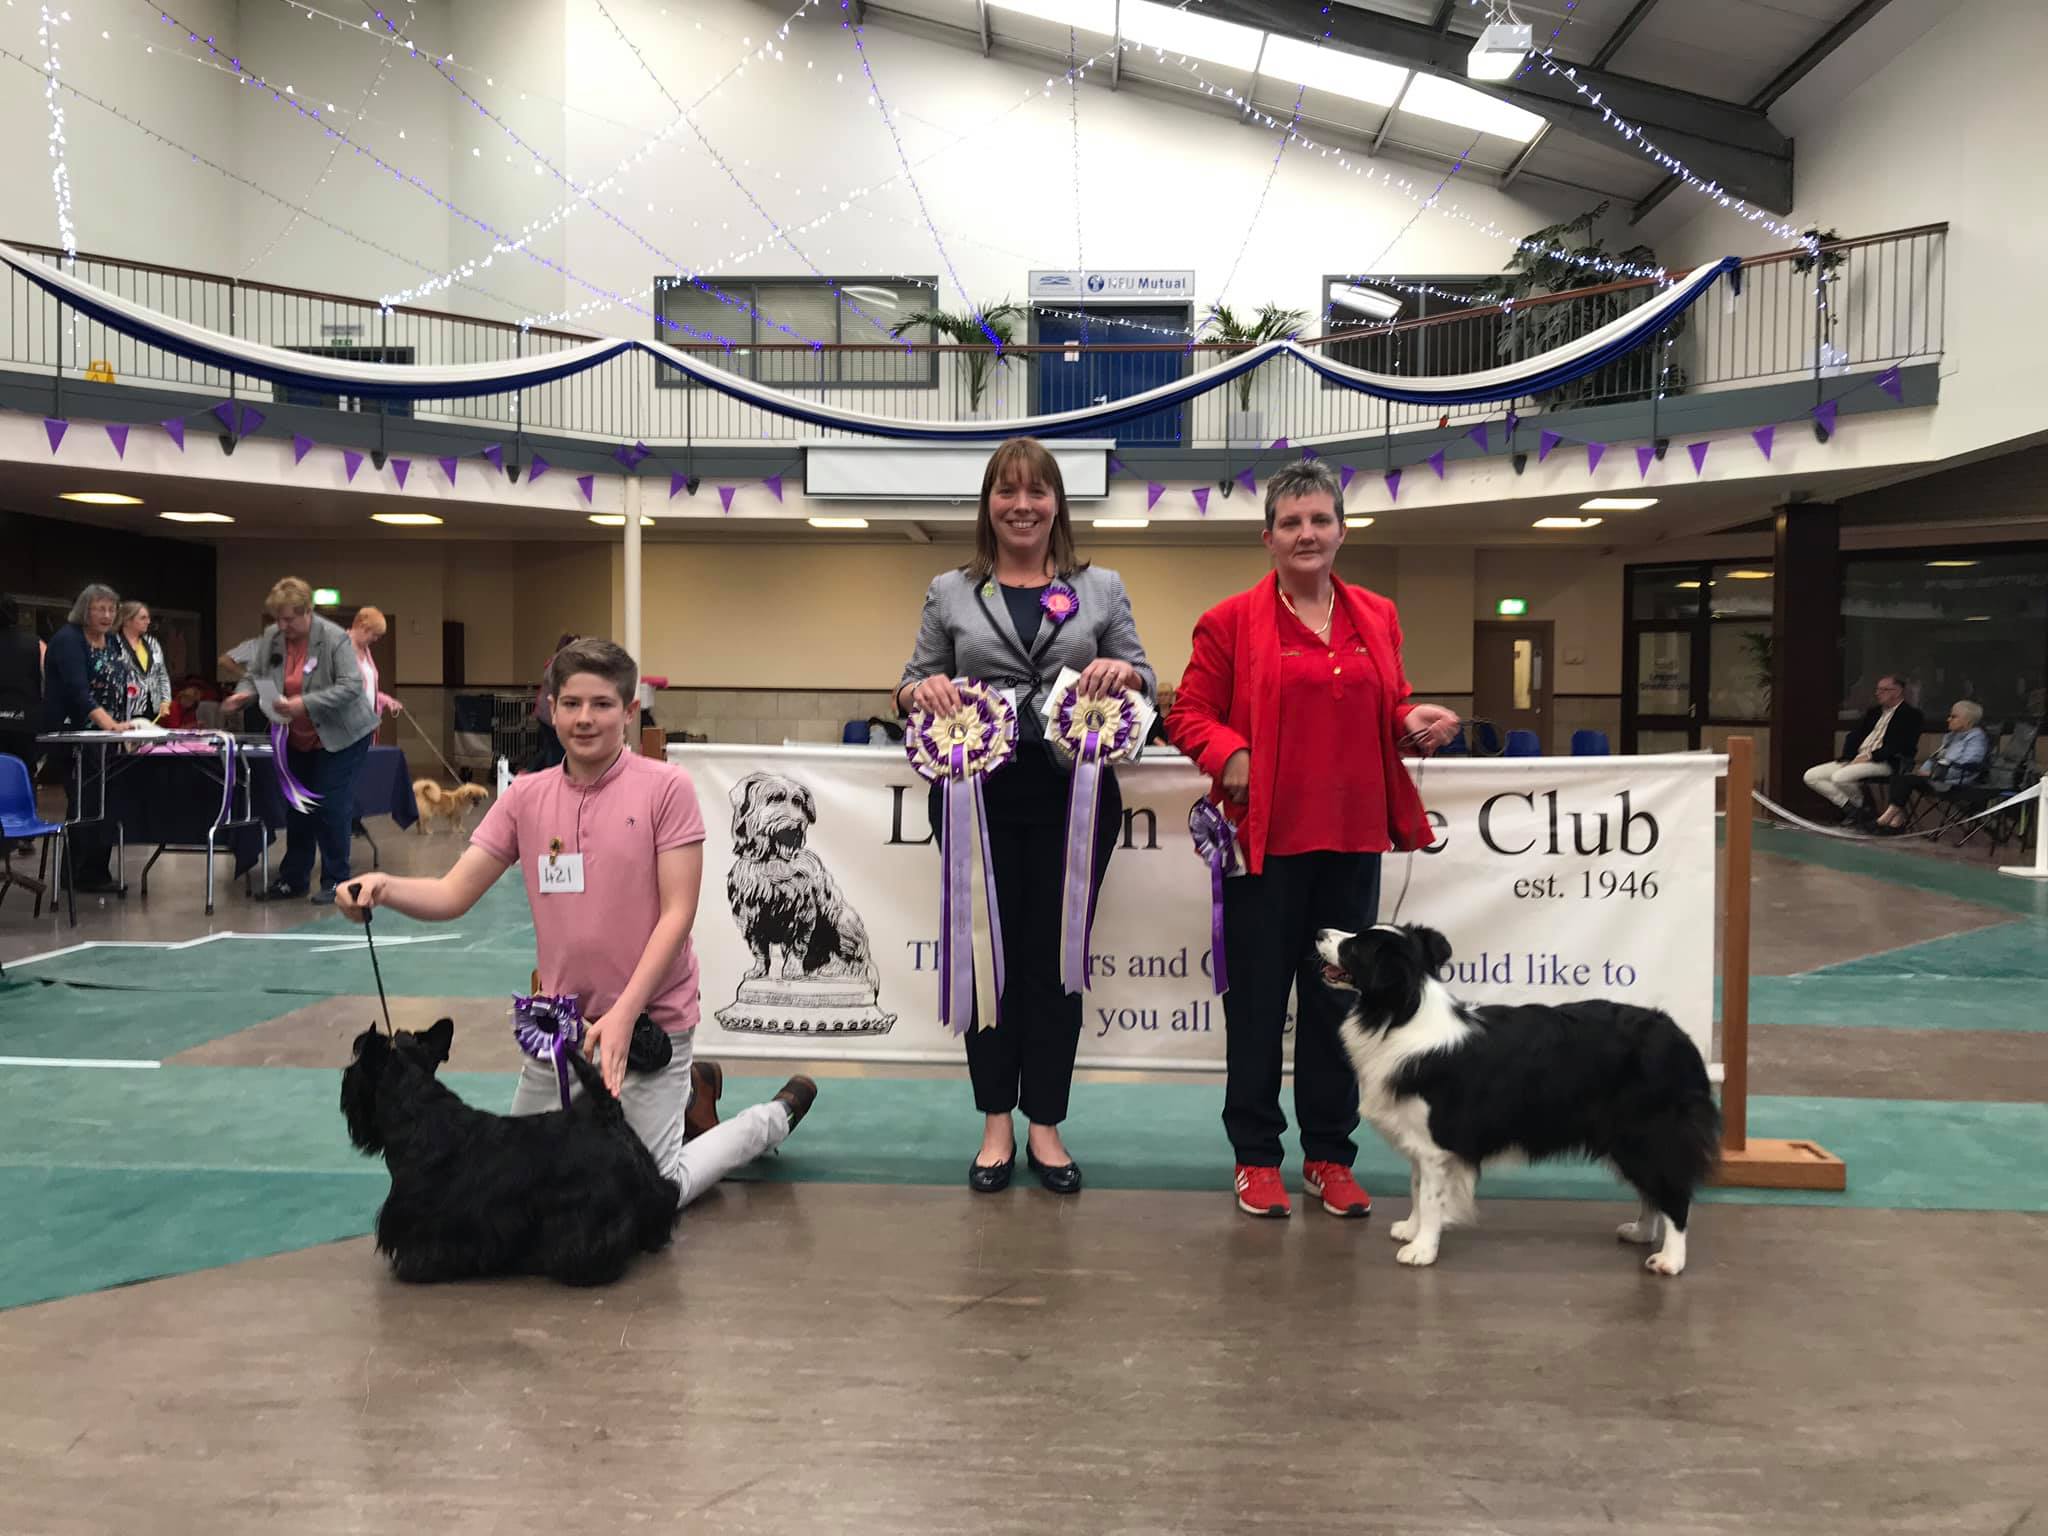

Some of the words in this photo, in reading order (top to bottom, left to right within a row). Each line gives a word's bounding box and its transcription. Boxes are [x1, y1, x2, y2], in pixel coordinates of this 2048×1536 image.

[1138, 277, 1186, 289] Mutual
[1478, 789, 1660, 856] Club
[1513, 873, 1565, 899] est.
[1580, 870, 1660, 900] 1946
[1128, 947, 1189, 978] and
[1438, 952, 1513, 984] ould
[1526, 953, 1591, 986] like
[1602, 959, 1637, 987] to
[1097, 1007, 1160, 1037] you
[1171, 1000, 1213, 1032] all
